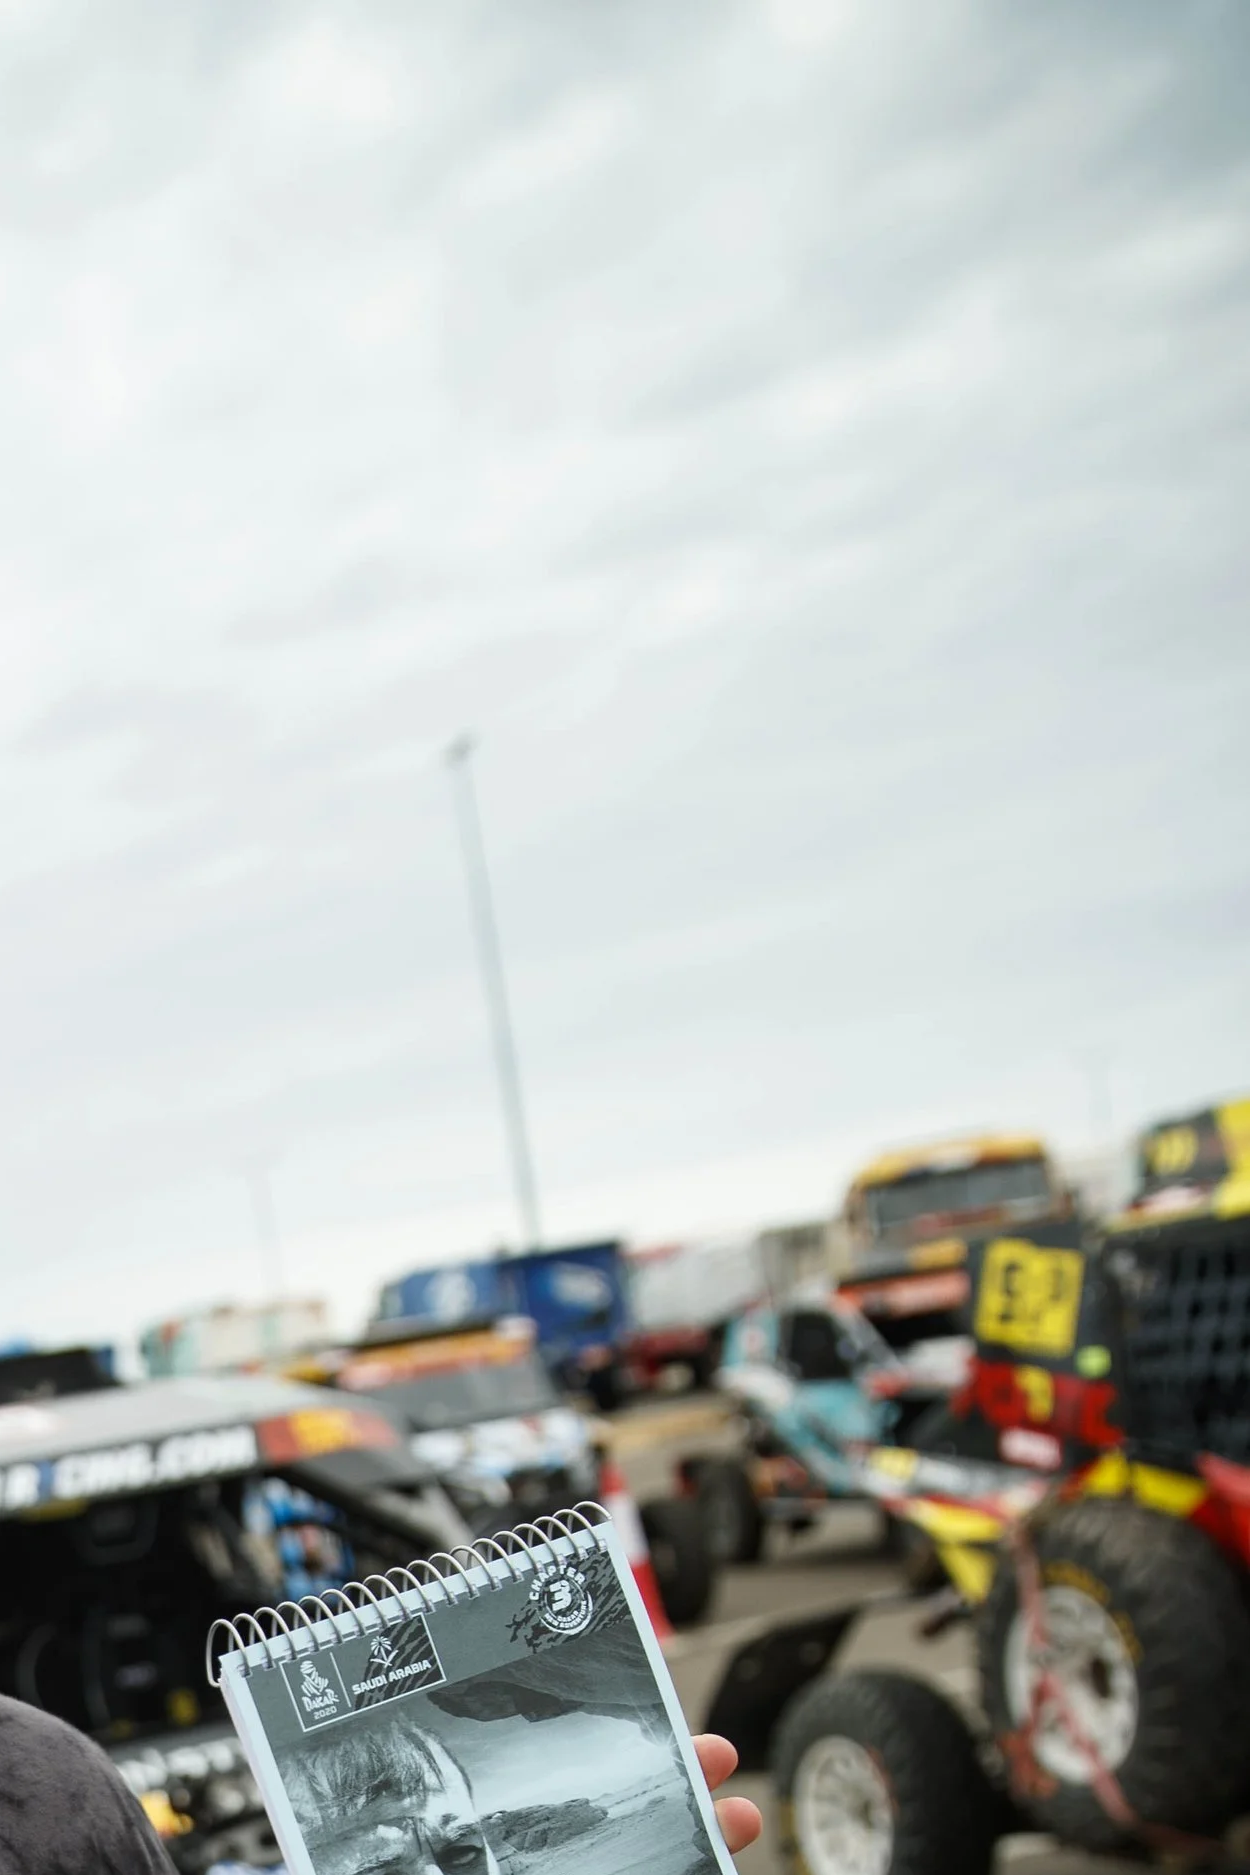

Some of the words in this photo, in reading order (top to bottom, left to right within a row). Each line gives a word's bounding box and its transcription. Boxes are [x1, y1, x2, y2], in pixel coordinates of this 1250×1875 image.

[529, 1564, 586, 1601] CHAPTER
[352, 1674, 388, 1695] SAUDI
[389, 1659, 432, 1682] ARABIA
[302, 1688, 339, 1712] DAKAR
[313, 1705, 338, 1720] 2020
